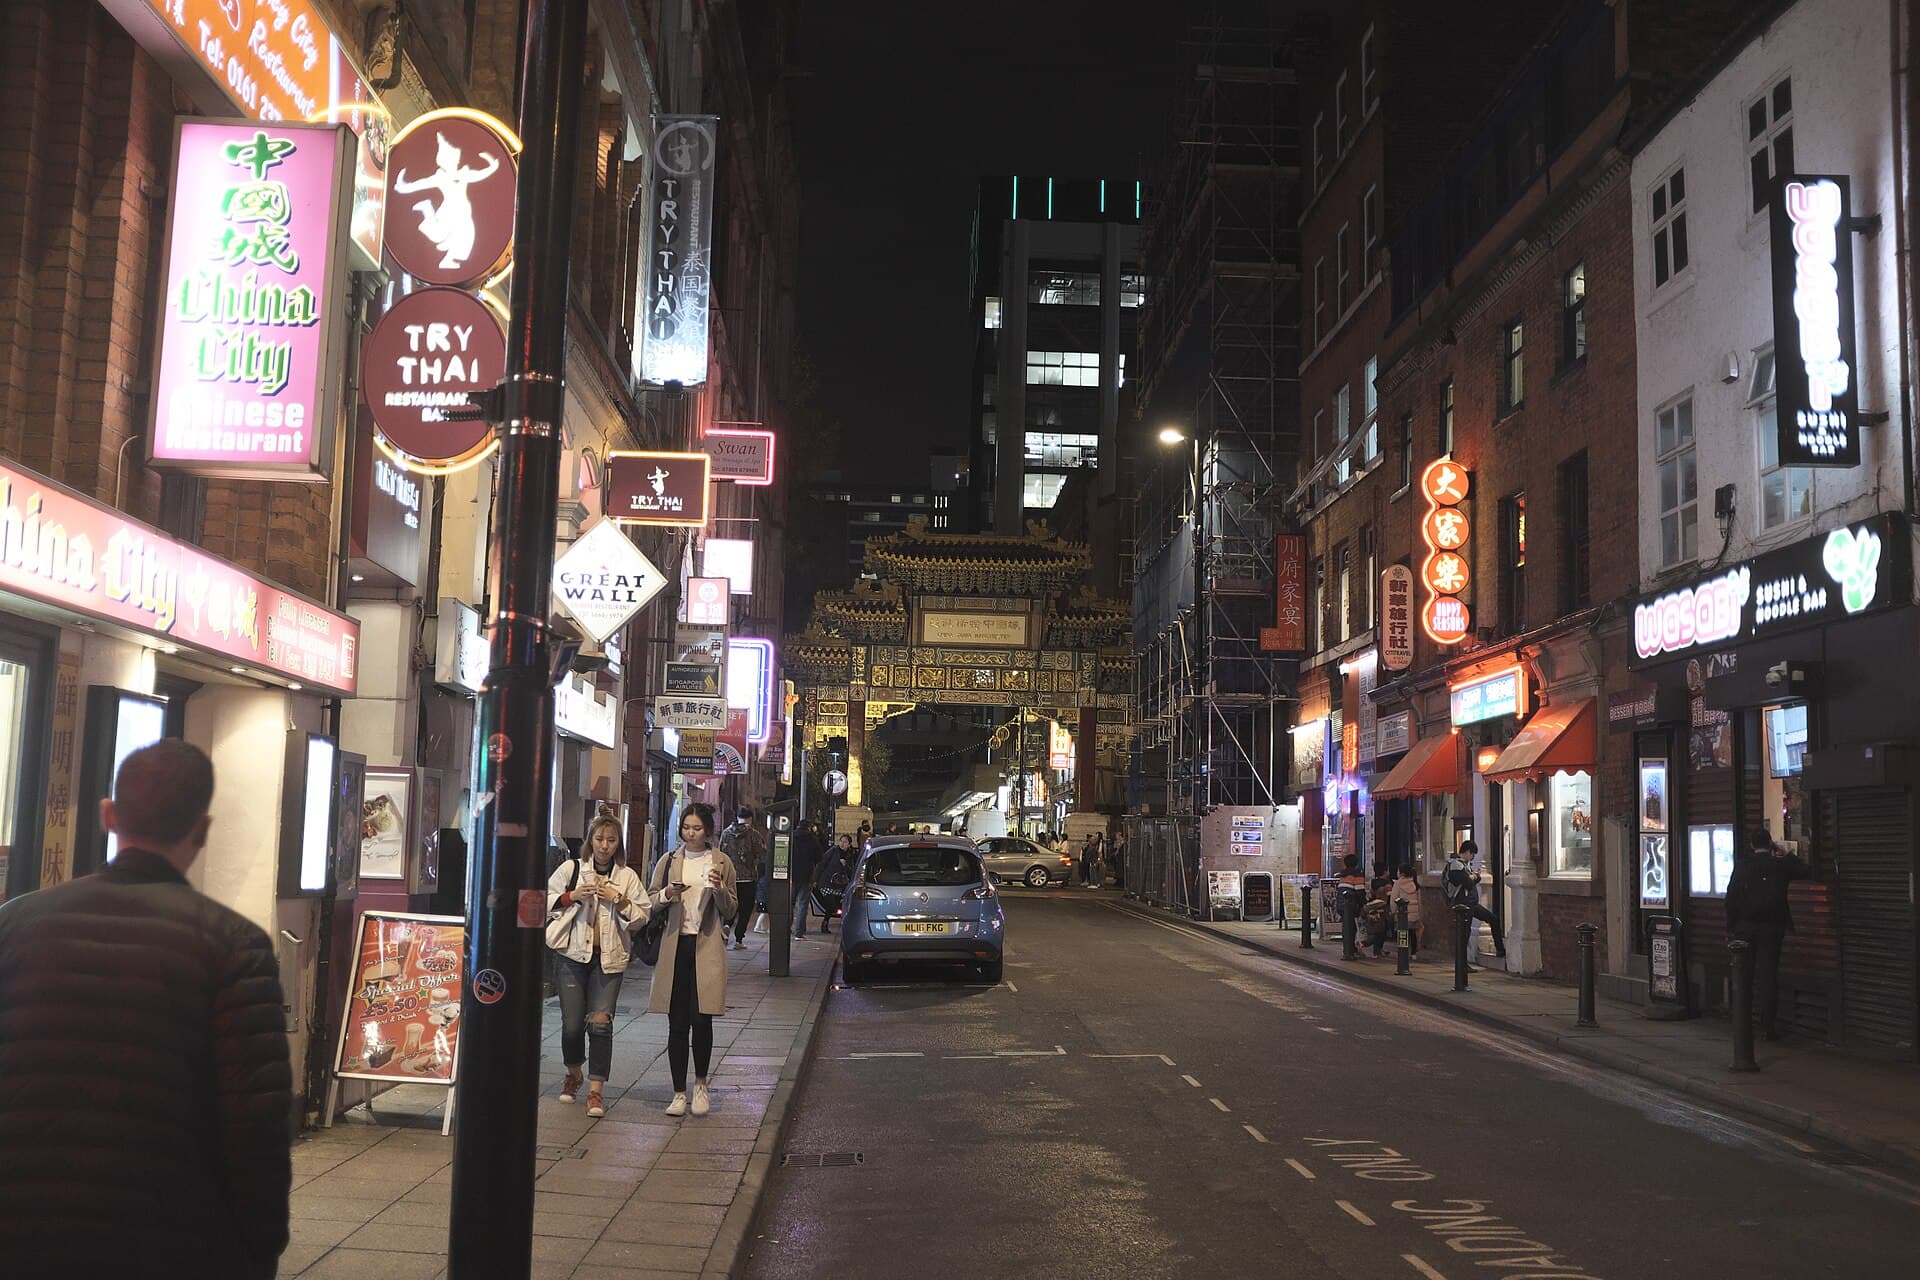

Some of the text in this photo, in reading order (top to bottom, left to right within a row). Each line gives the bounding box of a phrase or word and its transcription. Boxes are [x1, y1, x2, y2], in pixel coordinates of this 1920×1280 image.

[291, 14, 319, 71] City
[198, 20, 224, 70] Tel:
[227, 57, 257, 110] 0161
[248, 18, 315, 120] Restaurant
[206, 131, 300, 275] 中國城
[176, 271, 320, 329] China
[404, 322, 473, 352] TRY
[192, 328, 292, 397] City
[396, 355, 479, 385] THAI
[1797, 410, 1846, 430] SUSHI
[714, 440, 757, 455] Swan
[1798, 431, 1847, 448] NOODLE
[1811, 444, 1835, 456] BAR
[632, 495, 683, 506] TRY THAI
[1434, 466, 1464, 592] 大家樂
[0, 476, 179, 633] hina City
[560, 572, 645, 588] GREAT
[1280, 537, 1302, 626] 川府家宴
[1756, 575, 1795, 605] SUSHI
[565, 587, 637, 603] WALL
[1756, 587, 1827, 624] NOODLE BAR
[1435, 602, 1462, 617] HAPPY
[1433, 616, 1465, 632] SEASONS
[660, 701, 723, 720] 新華旅行社
[683, 743, 709, 753] Services
[779, 815, 789, 831] P
[926, 923, 944, 932] FKG
[359, 979, 416, 1000] Special
[418, 972, 459, 988] Offer
[360, 996, 418, 1018] £5.50
[1303, 1137, 1436, 1181] ONLY
